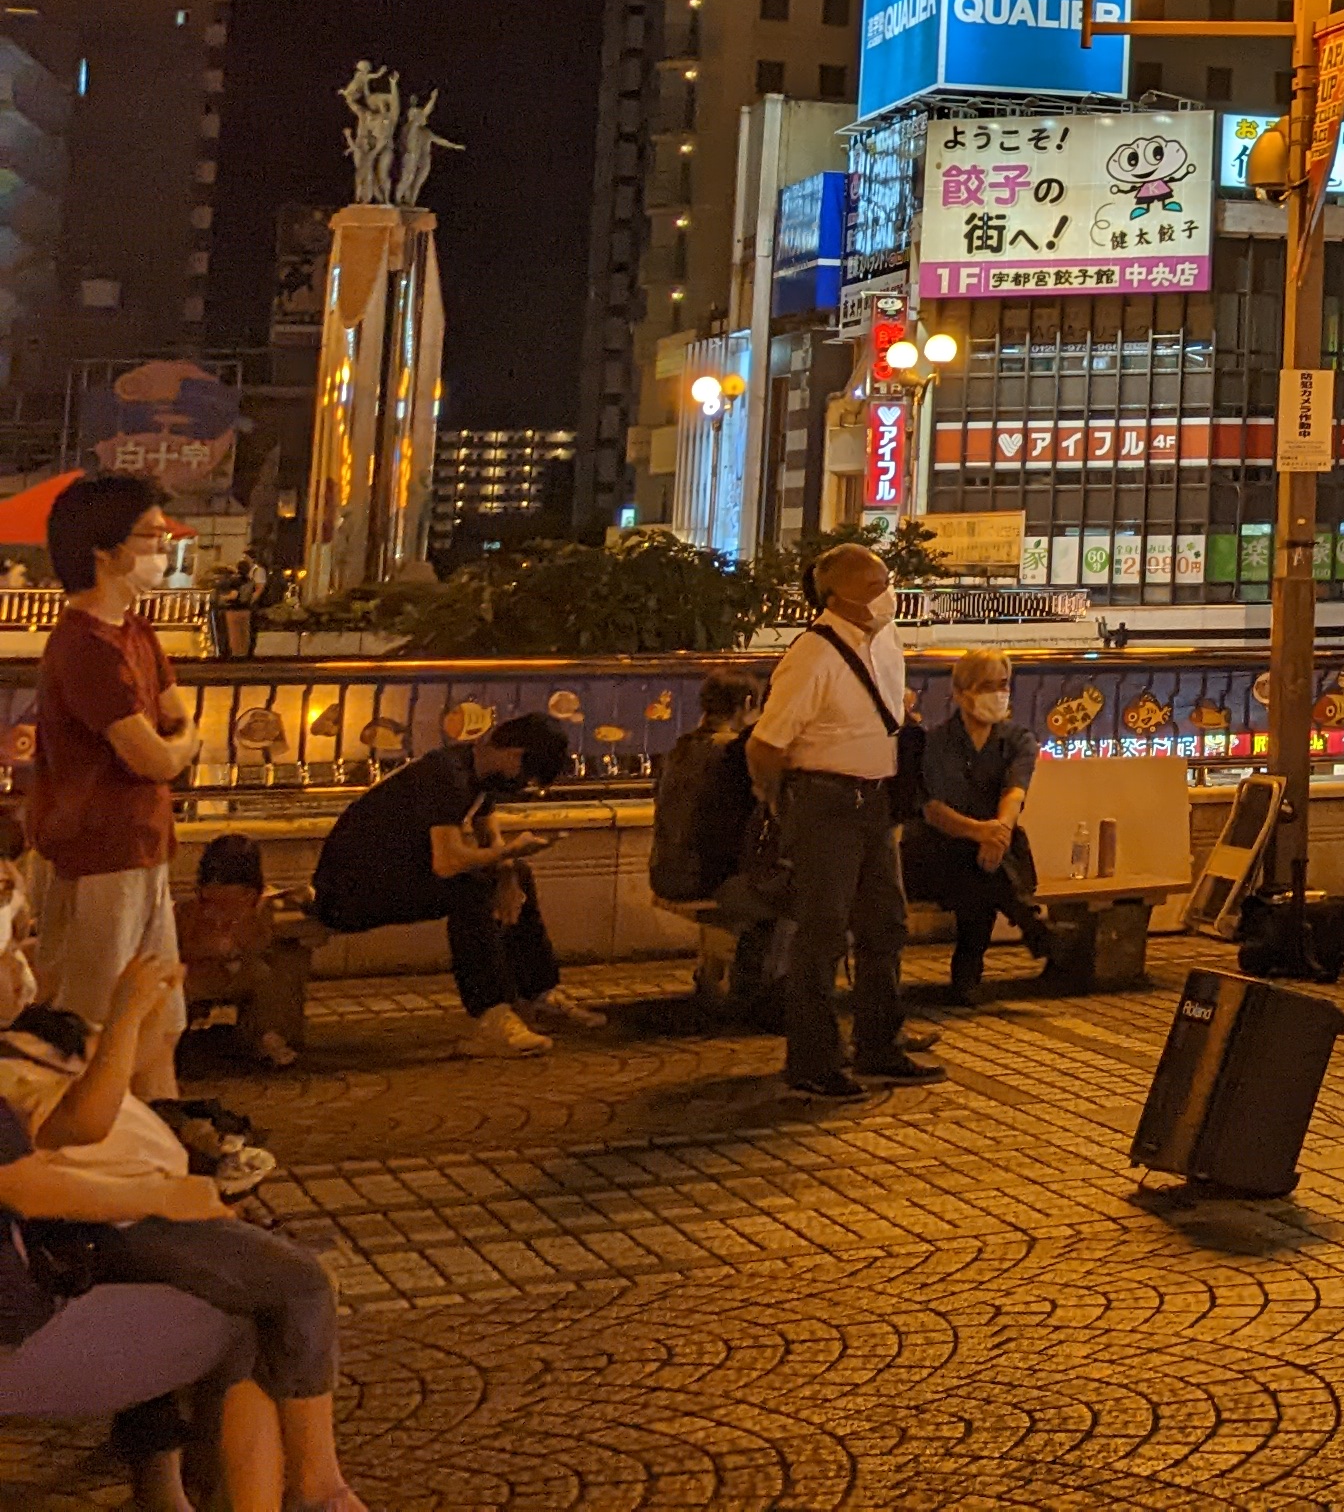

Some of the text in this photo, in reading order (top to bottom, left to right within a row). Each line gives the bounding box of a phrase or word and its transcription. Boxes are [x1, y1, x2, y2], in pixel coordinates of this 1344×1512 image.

[943, 125, 1070, 153] ようこそ!
[940, 163, 1065, 207] 餃子の
[963, 211, 1070, 255] 街へ!
[1110, 219, 1200, 251] 健太餃子
[934, 266, 982, 294] 1F
[991, 268, 1118, 289] 宇都宮餃子館
[1124, 261, 1199, 288] 中央店
[1030, 430, 1176, 457] アイフル 4F
[876, 425, 897, 501] アイフル
[1182, 999, 1213, 1020] Roland
